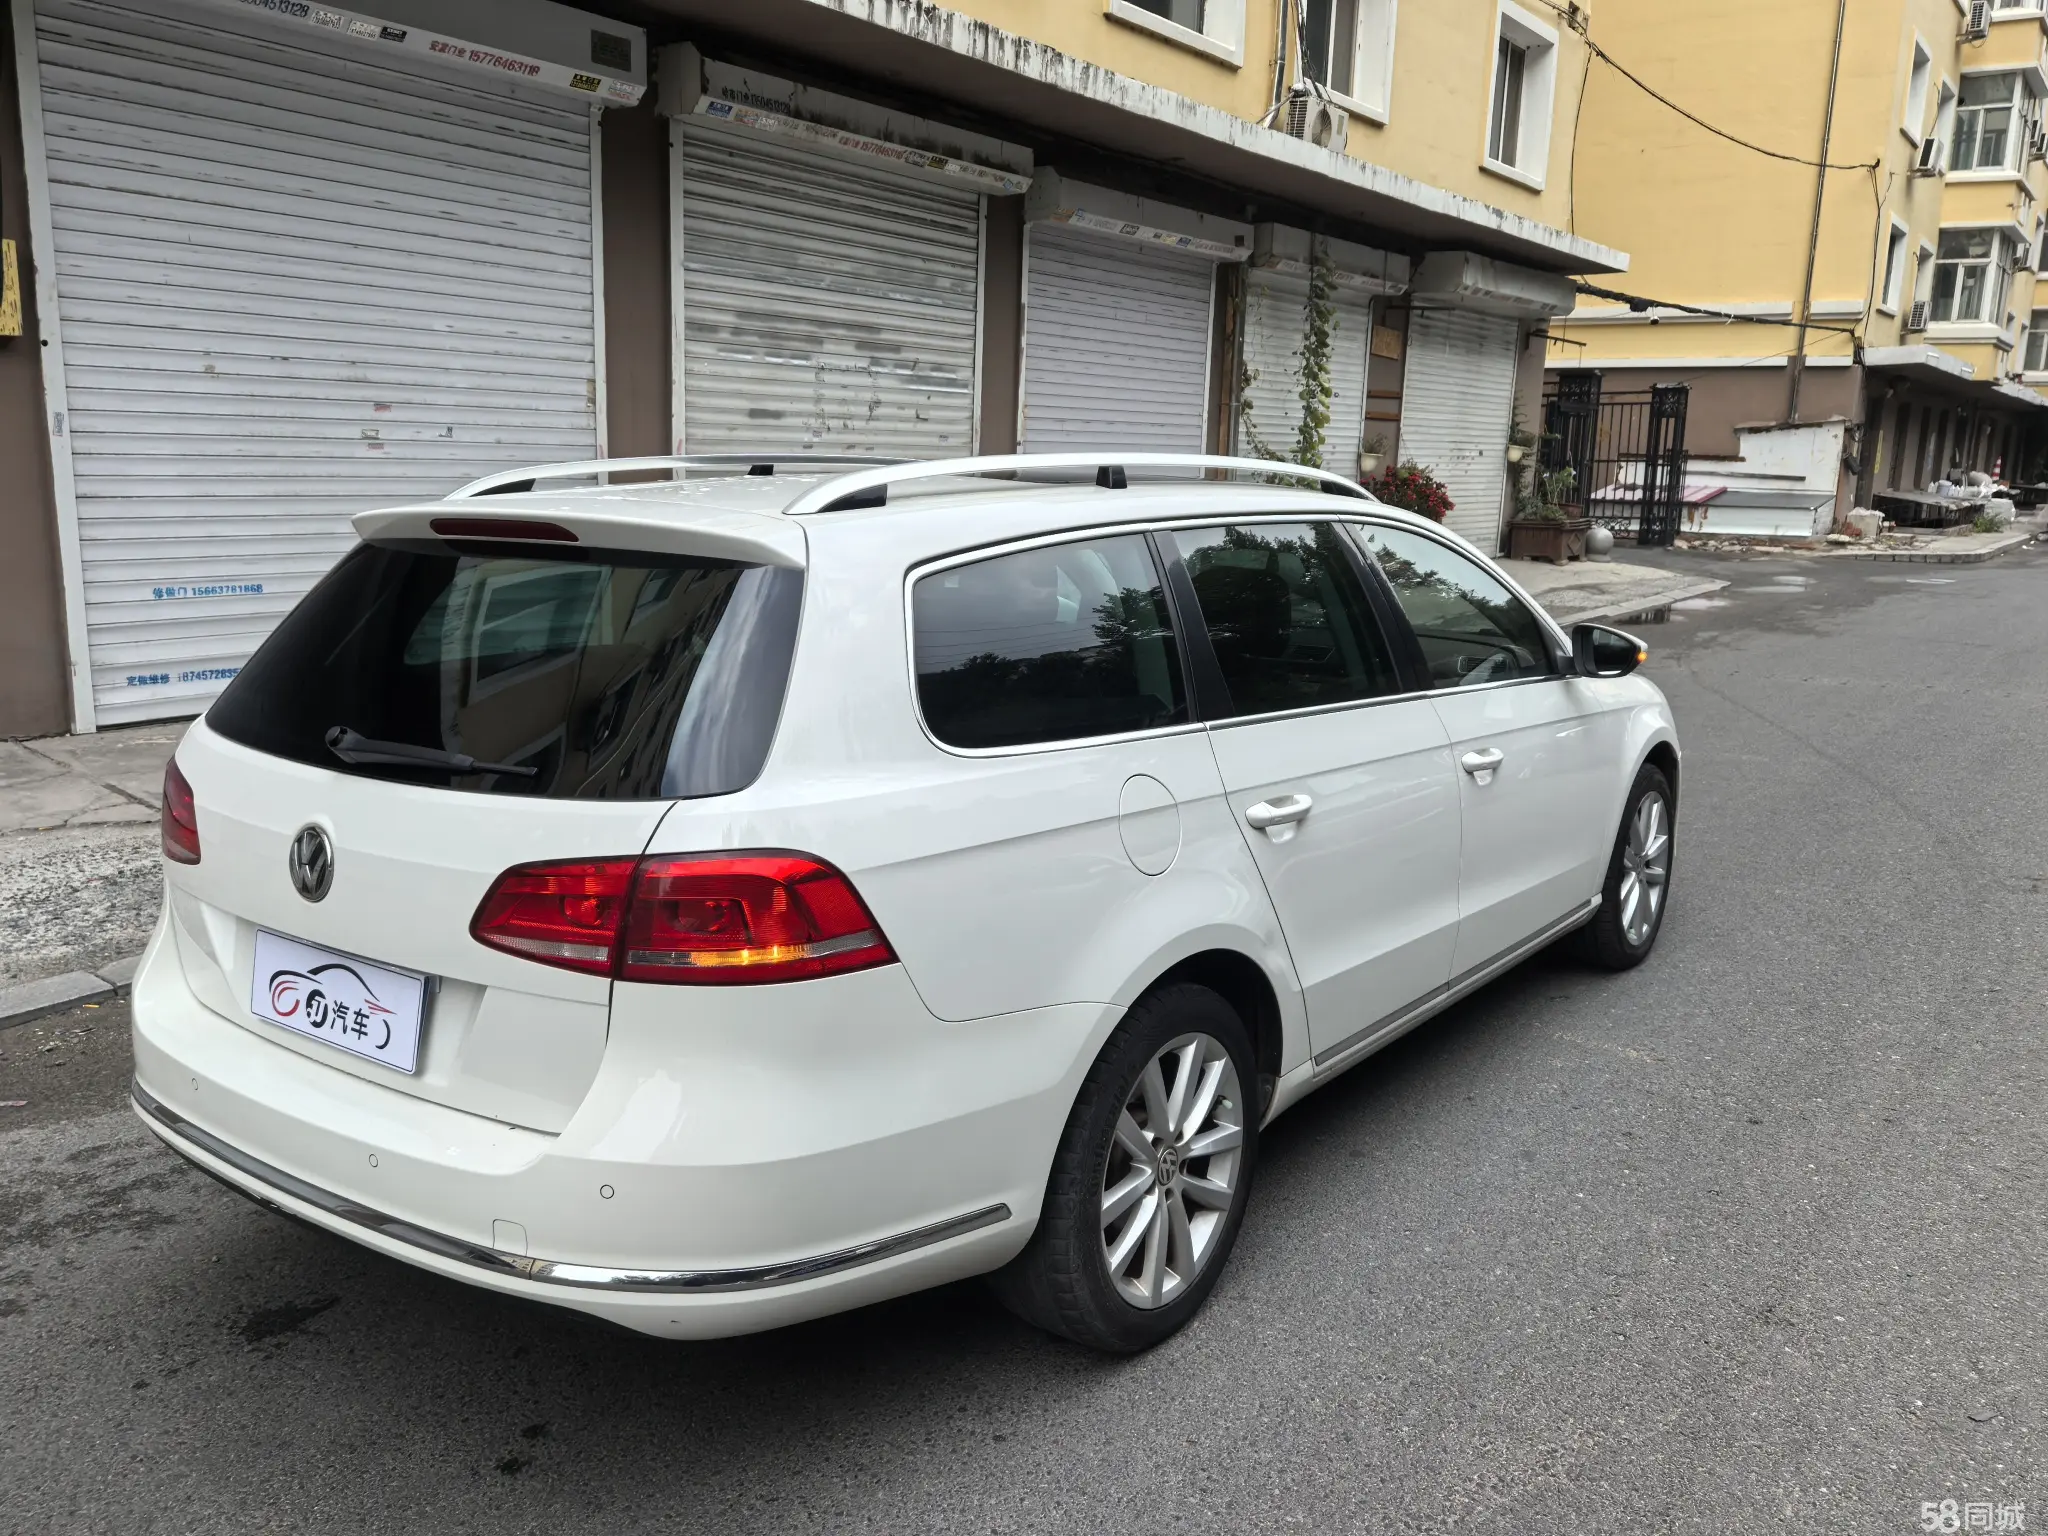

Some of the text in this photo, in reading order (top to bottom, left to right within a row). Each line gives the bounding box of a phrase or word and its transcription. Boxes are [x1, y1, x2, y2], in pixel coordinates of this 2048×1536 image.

[468, 49, 540, 76] 15776463118
[191, 583, 264, 597] 15663781868
[177, 667, 242, 683] 1874572835
